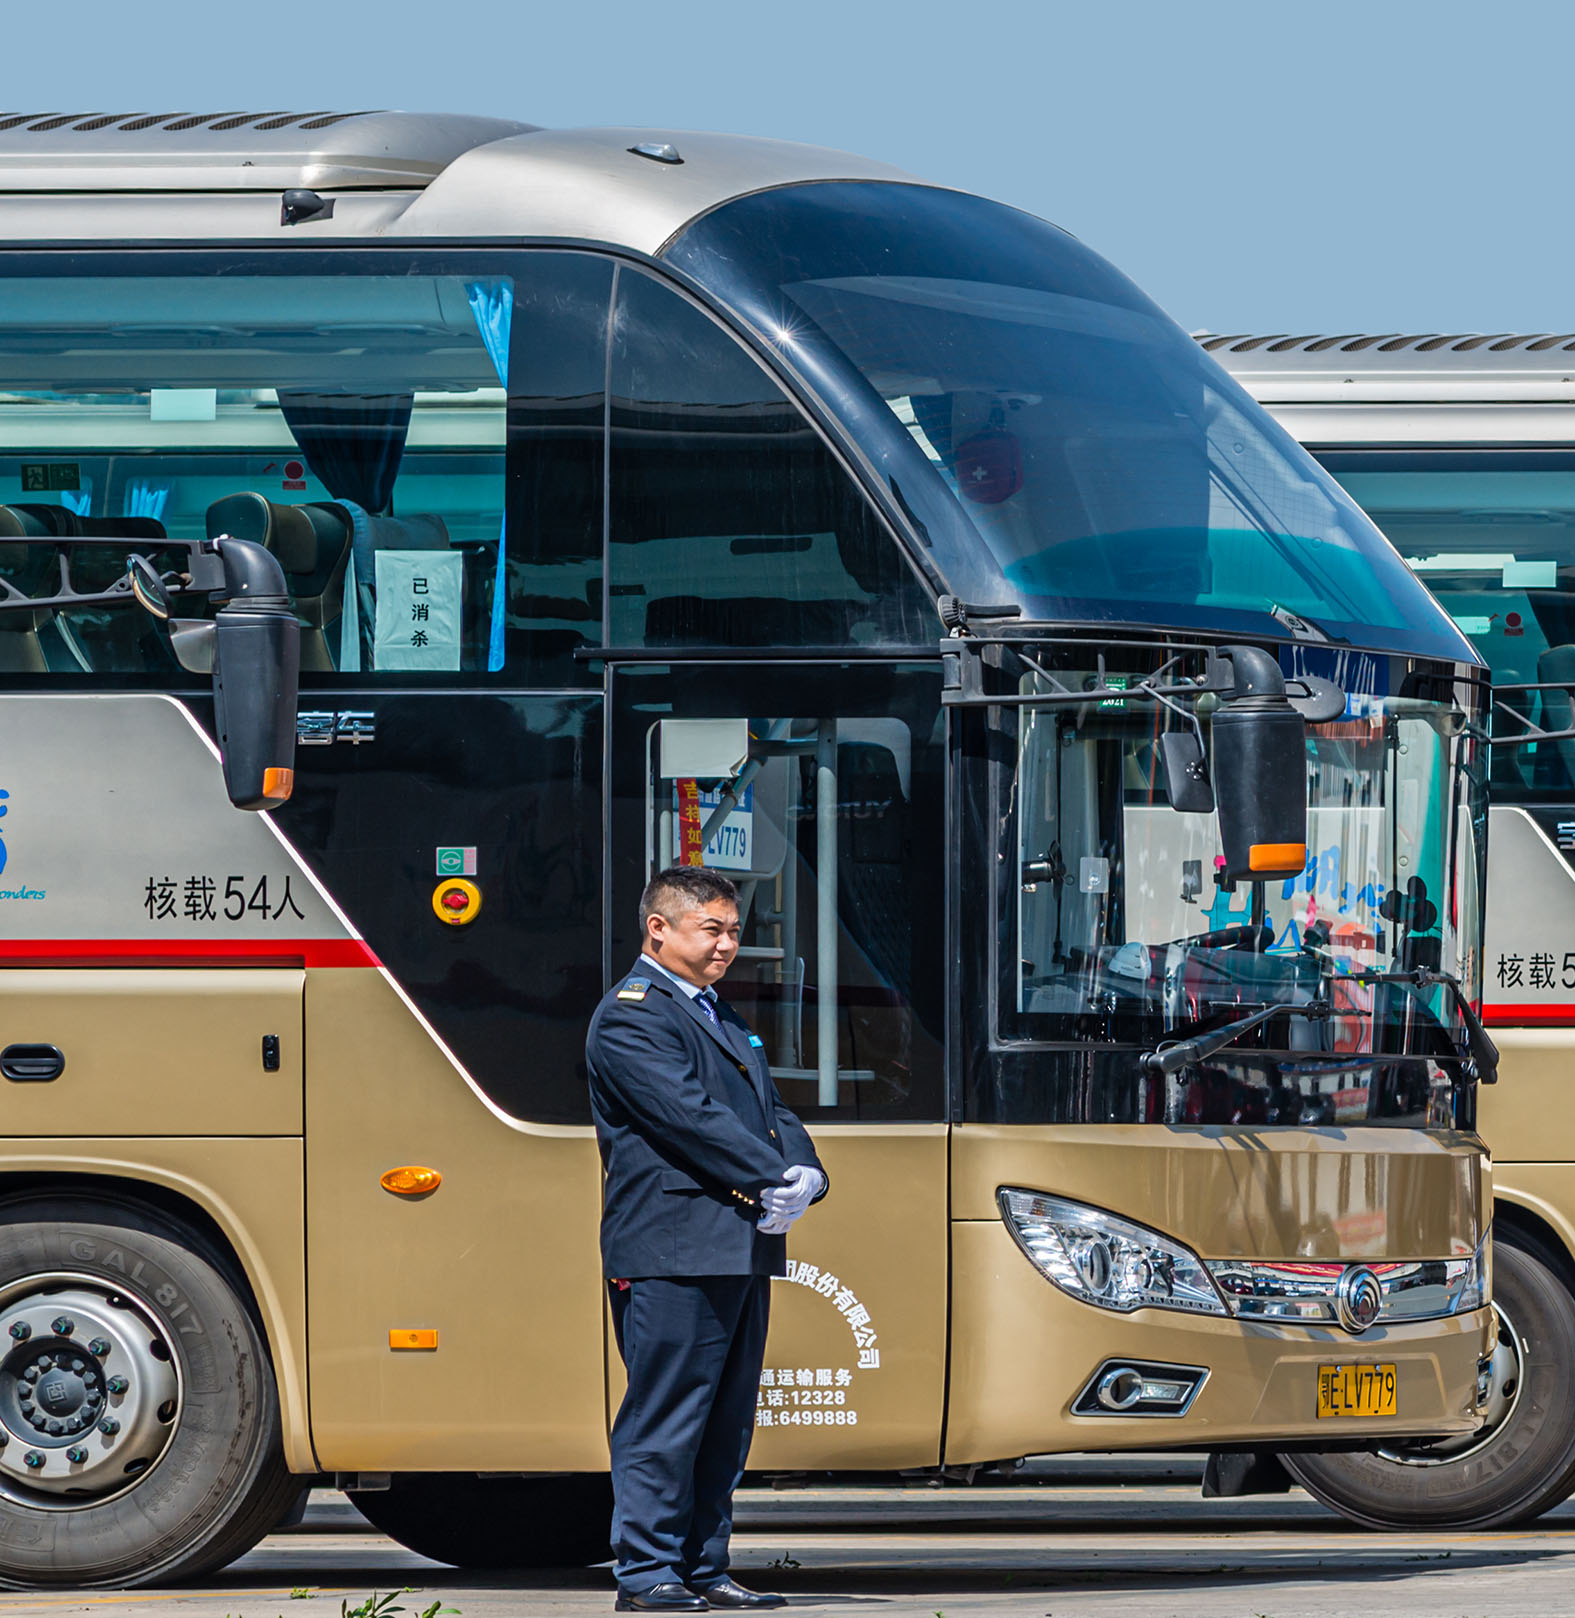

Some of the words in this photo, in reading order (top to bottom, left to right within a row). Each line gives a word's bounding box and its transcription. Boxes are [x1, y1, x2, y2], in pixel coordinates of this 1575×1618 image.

[411, 578, 429, 647] 已消杀
[144, 875, 305, 921] 核载54人
[760, 1368, 852, 1387] 通运输服务
[756, 1409, 858, 1426] 报:6499888
